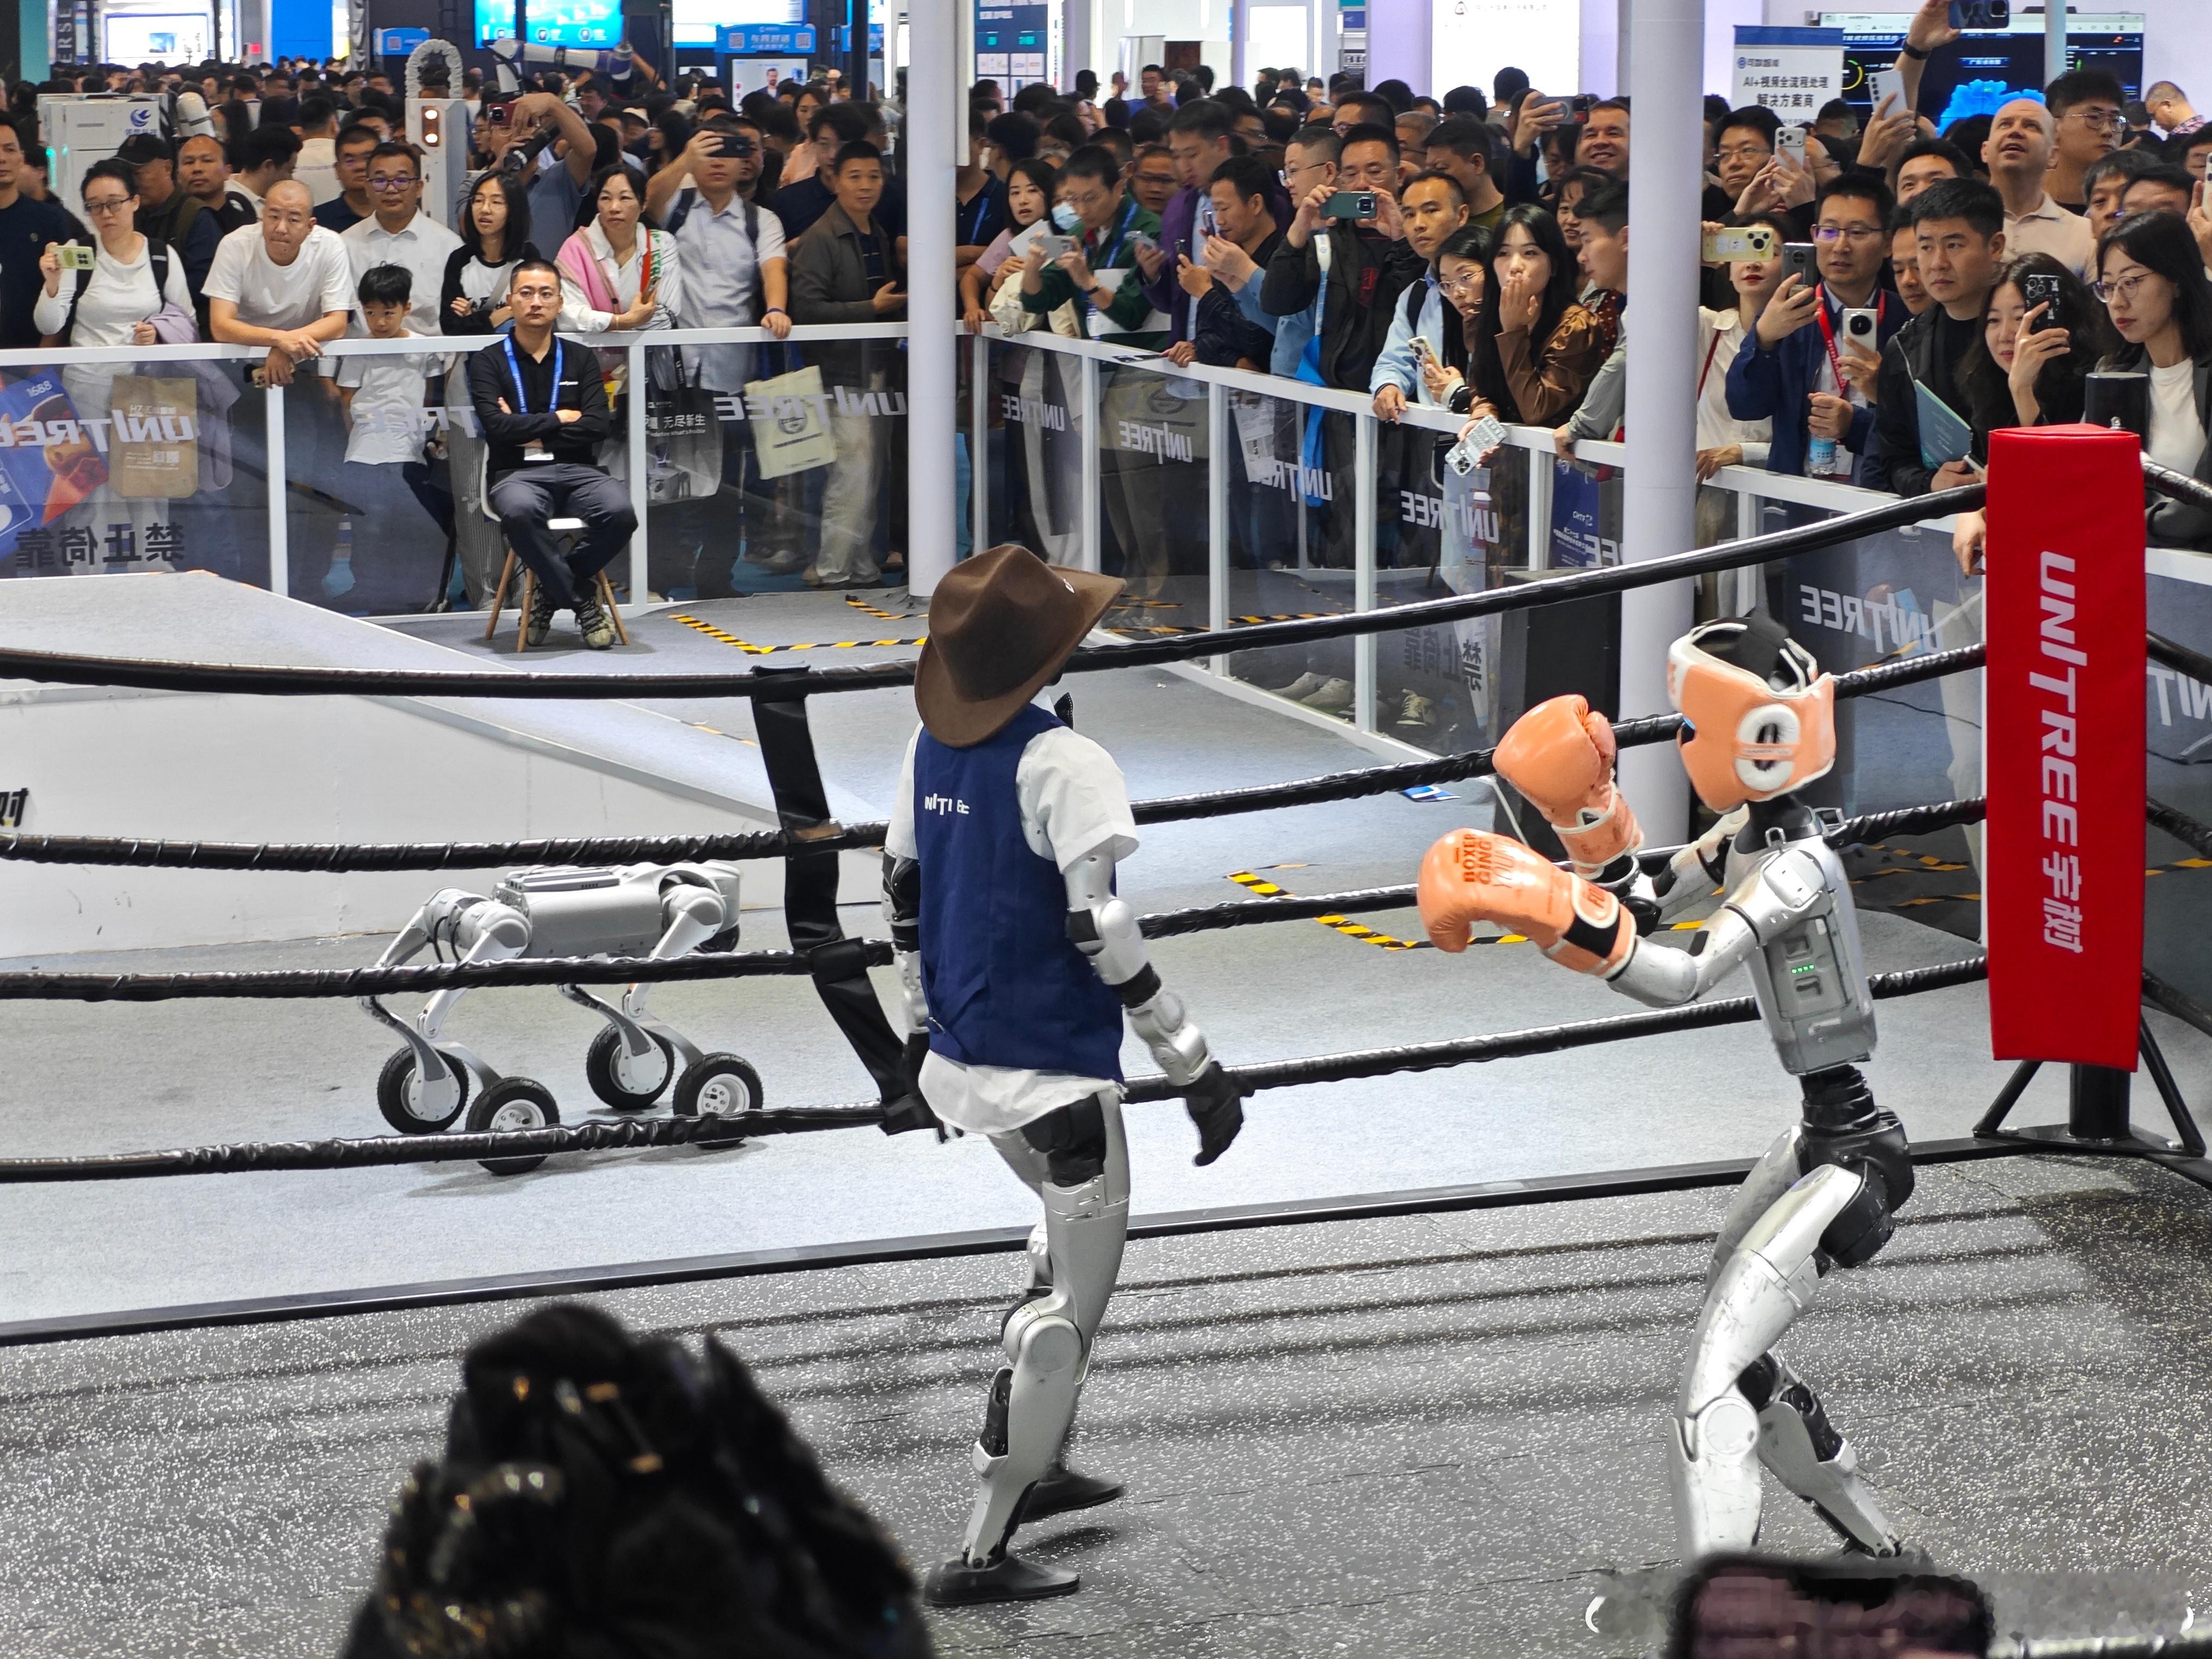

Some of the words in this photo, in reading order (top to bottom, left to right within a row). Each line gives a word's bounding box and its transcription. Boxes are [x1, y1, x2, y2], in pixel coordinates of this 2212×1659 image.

[27, 380, 53, 397] 1688
[2029, 551, 2088, 847] UNITREE
[2042, 851, 2084, 954] 宇树
